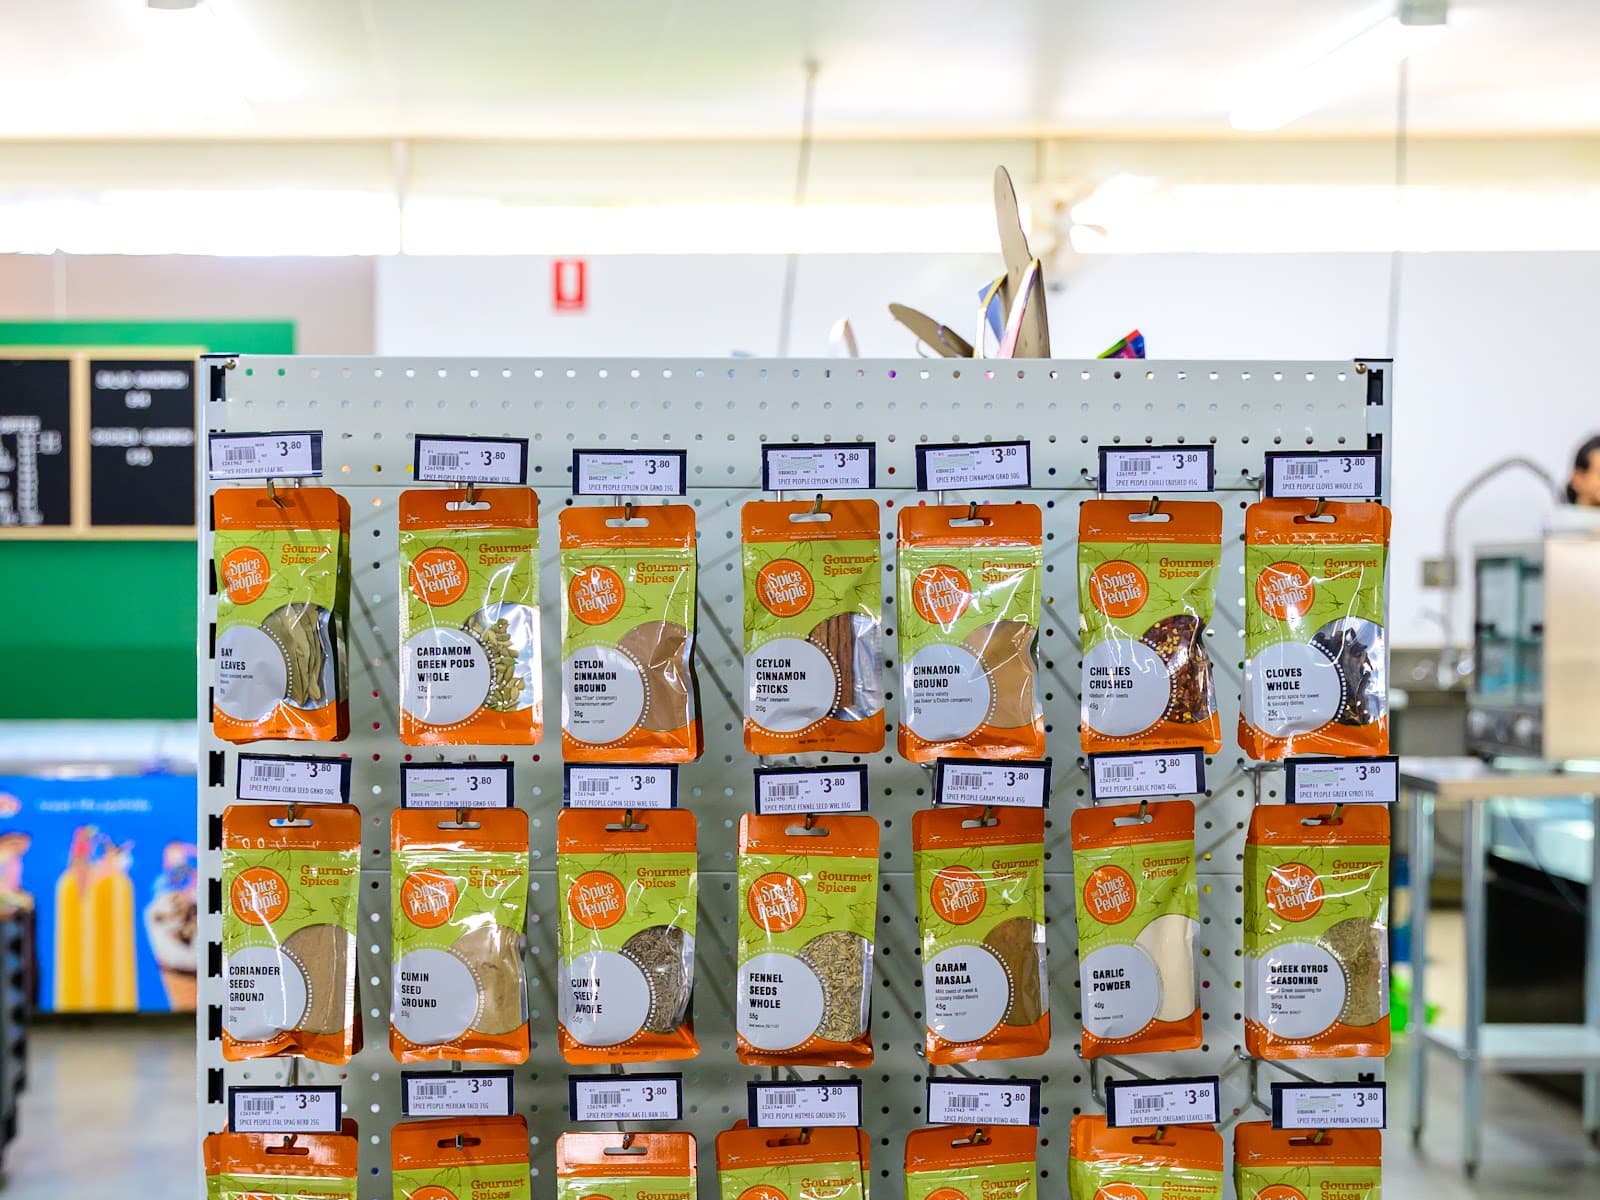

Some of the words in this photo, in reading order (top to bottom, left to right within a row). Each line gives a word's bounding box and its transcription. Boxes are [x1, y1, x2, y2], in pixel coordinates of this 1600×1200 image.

[481, 451, 505, 466] $3.80
[834, 452, 859, 468] $3.80
[991, 448, 1017, 463] $3.80
[823, 554, 878, 564] Gourmet
[823, 566, 863, 575] Spices
[768, 570, 802, 589] Spice
[765, 584, 807, 606] People
[417, 646, 471, 656] CARDAMOM
[221, 660, 246, 671] LEAVES
[417, 659, 447, 669] GREEN
[450, 659, 475, 668] PODS
[574, 660, 604, 669] CEYLON
[756, 658, 791, 668] CEYLON
[913, 665, 960, 676] CINNAMON
[1266, 668, 1302, 679] CLOVES
[417, 672, 449, 682] WHOLE
[574, 672, 616, 681] CINNAMON
[756, 671, 806, 681] CINNAMON
[574, 684, 606, 693] GROUND
[913, 678, 948, 689] GROUND
[1089, 679, 1133, 689] CRUSHED
[1266, 681, 1300, 691] WHOLE
[756, 684, 788, 694] STICKS
[1355, 765, 1381, 781] $3.80
[467, 776, 492, 791] $3.80
[1004, 771, 1029, 786] $3.80
[818, 872, 872, 882] Gourmet
[818, 882, 856, 892] Spices
[229, 966, 280, 976] CORIANDER
[935, 962, 967, 972] GARAM
[1271, 965, 1299, 973] GREEK
[1301, 964, 1328, 973] GYROS
[401, 971, 429, 982] CUMIN
[750, 973, 784, 983] FENNEL
[1093, 968, 1124, 979] GARLIC
[229, 979, 255, 989] SEEDS
[935, 975, 971, 985] MASALA
[1271, 976, 1318, 985] SEASONING
[401, 984, 421, 995] SEED
[749, 985, 777, 996] SEEDS
[1093, 980, 1131, 992] POWDER
[230, 992, 264, 1002] GROUND
[401, 997, 437, 1008] GROUND
[749, 998, 781, 1009] WHOLE
[817, 1087, 842, 1102] $3.80
[1185, 1089, 1210, 1104] $3.80
[295, 1094, 320, 1109] $3.80
[471, 1178, 524, 1189] Gourmet
[472, 1190, 510, 1200] Spices
